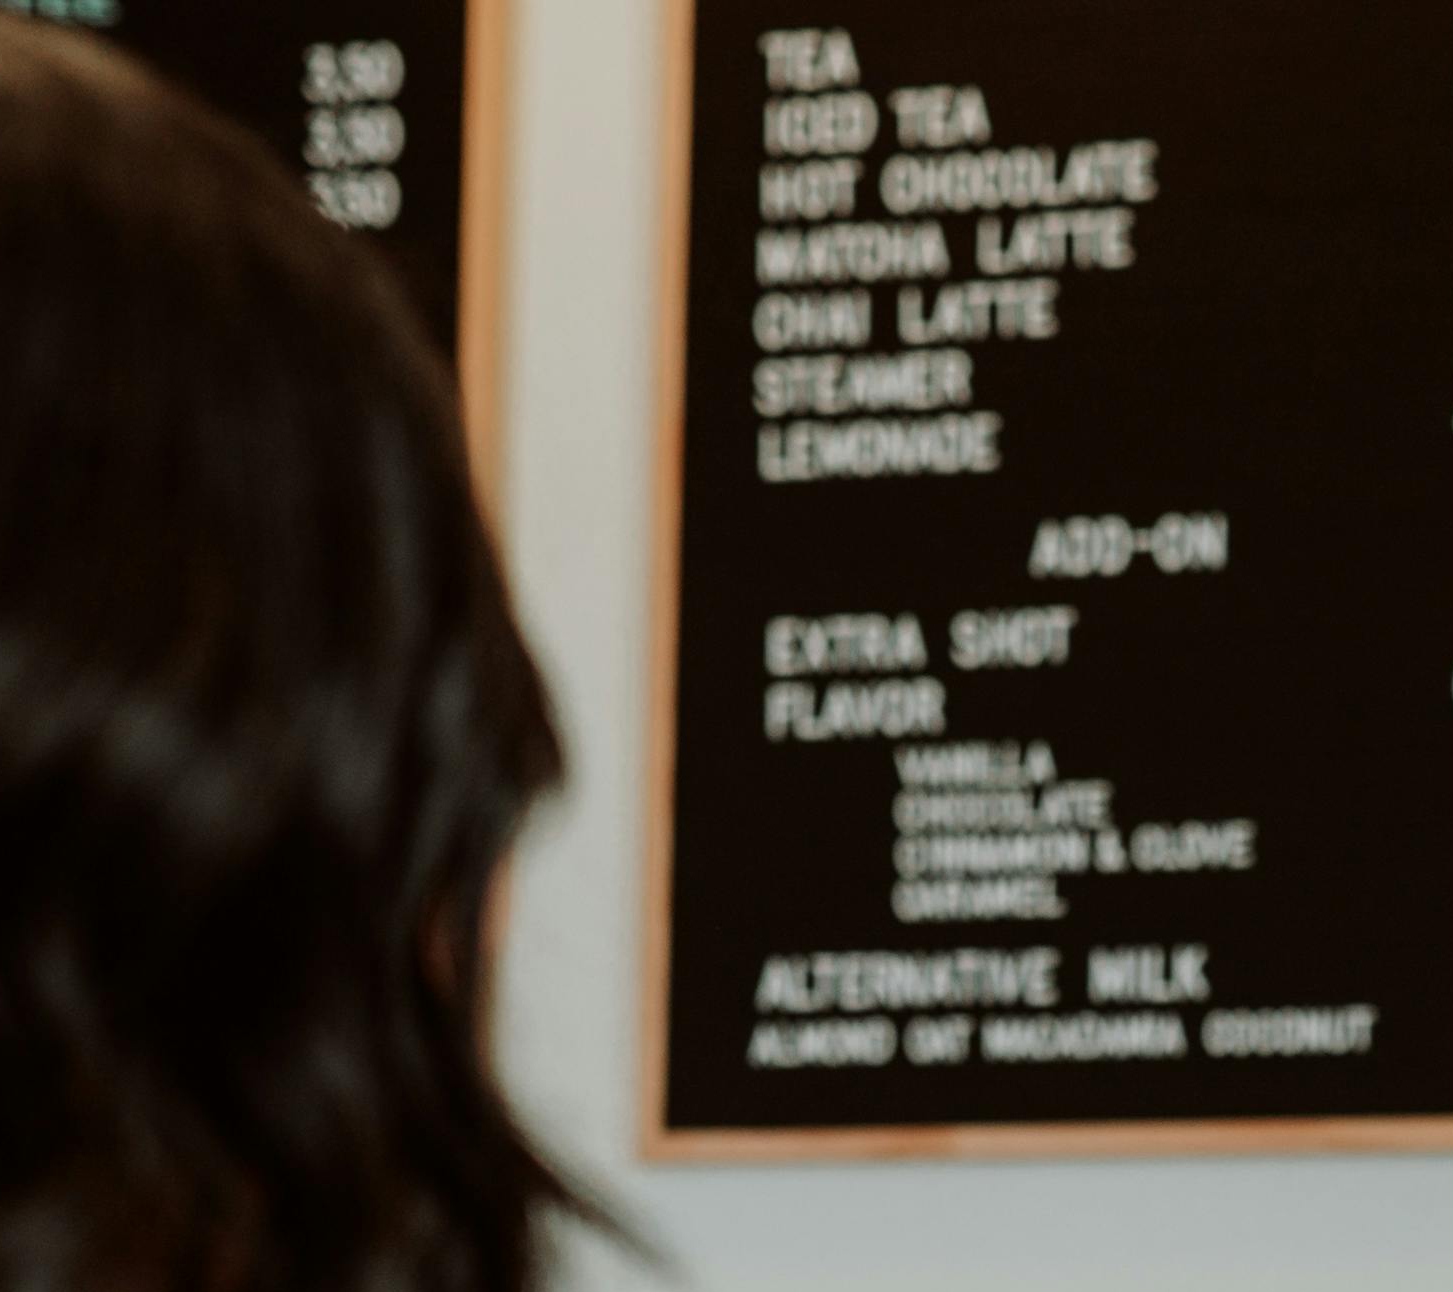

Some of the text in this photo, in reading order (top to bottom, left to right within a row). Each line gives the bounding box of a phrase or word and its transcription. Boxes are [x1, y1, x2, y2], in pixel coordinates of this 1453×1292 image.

[761, 30, 858, 87] TEA
[766, 93, 875, 153] ICED
[893, 87, 989, 145] TEA
[761, 159, 860, 217] HOT
[883, 141, 1156, 212] CHOCOLATE
[758, 224, 947, 282] MATCHA
[979, 210, 1133, 272] LATTE
[756, 290, 869, 348] CHAI
[899, 280, 1056, 342] LATTE
[756, 352, 969, 413] STEAMER
[761, 415, 998, 479] LEMONADE
[1032, 516, 1225, 575] ADD-ON
[768, 616, 924, 673] EXTRA
[952, 610, 1074, 665] SHOT
[768, 681, 942, 737] FLAVOR
[898, 741, 1052, 786] VANILLA
[897, 783, 1111, 832] CHOCOLATE
[897, 829, 1086, 873] CINNAMON
[1135, 823, 1254, 866] CLOVE
[895, 877, 1064, 919] CARAMEL
[758, 950, 1057, 1008] ALTERNATIVE
[1090, 948, 1207, 999] MILK
[750, 1016, 893, 1065] ALMOND
[984, 1013, 1184, 1059] MACADAMIA
[1205, 1007, 1375, 1055] COCONUT
